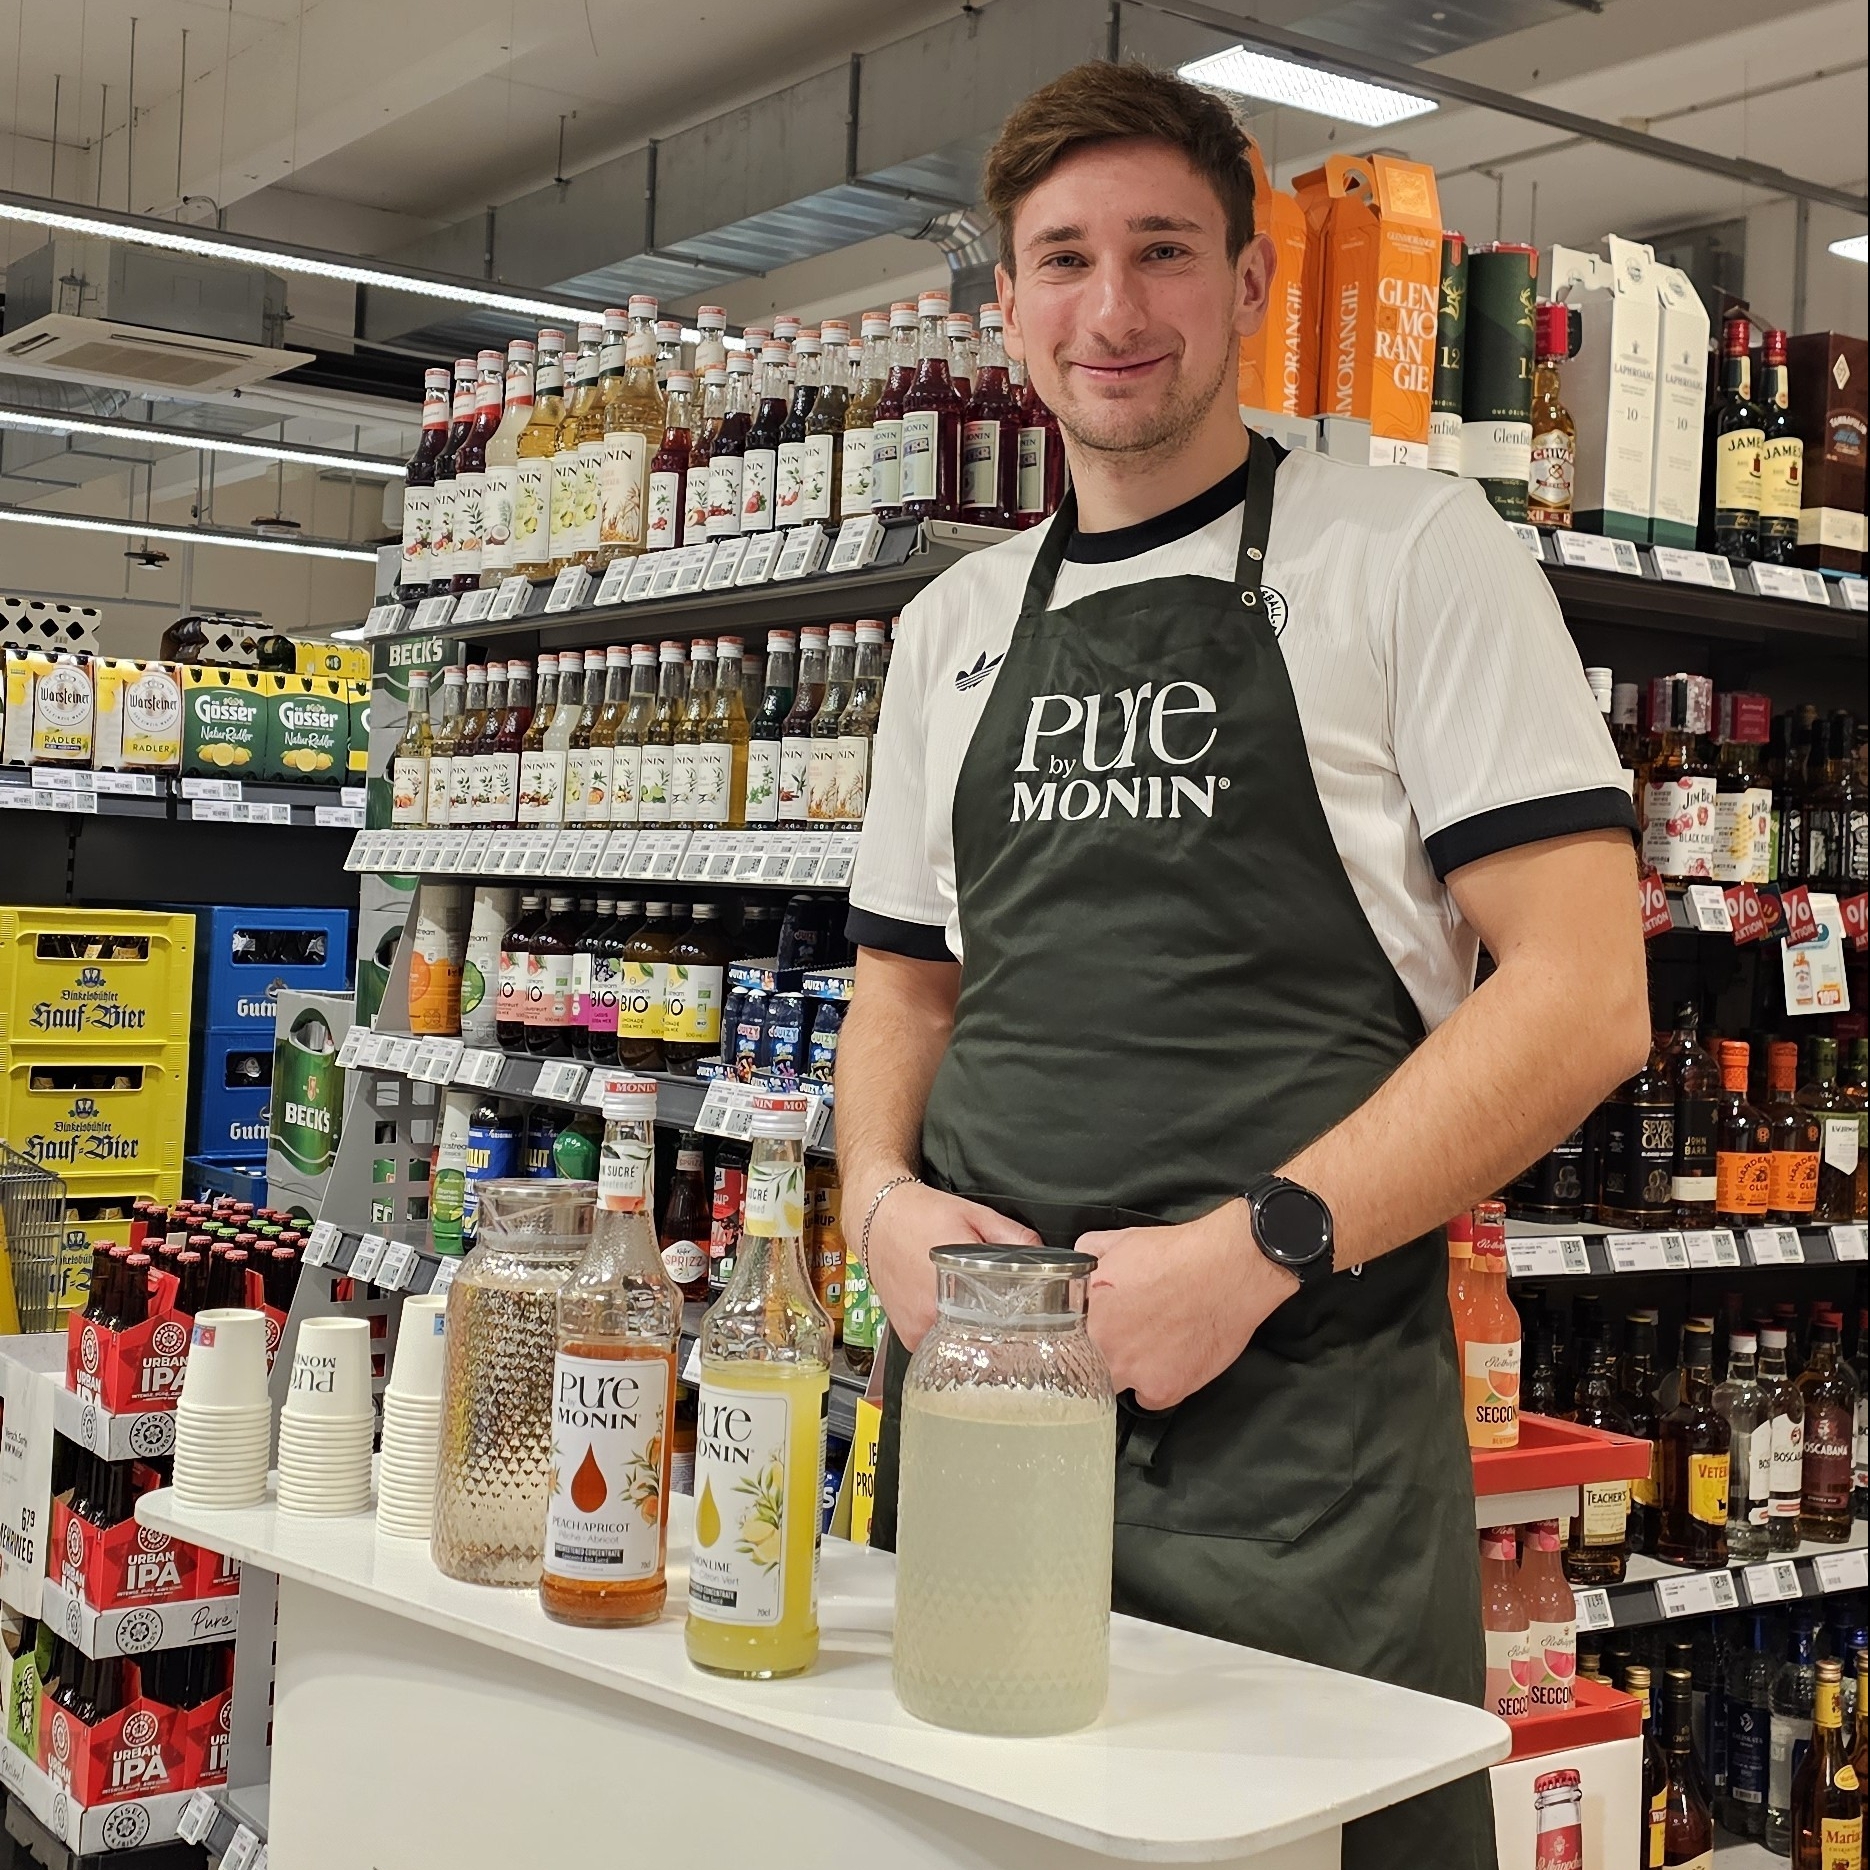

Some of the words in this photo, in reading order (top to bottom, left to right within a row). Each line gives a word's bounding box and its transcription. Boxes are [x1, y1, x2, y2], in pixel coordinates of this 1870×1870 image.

[1378, 277, 1439, 312] GLEN
[1398, 307, 1438, 338] MO
[1375, 330, 1423, 364] RAN
[1441, 346, 1460, 370] 12
[1393, 363, 1430, 393] GIE
[1627, 407, 1638, 421] 10
[1677, 417, 1688, 431] 10
[1392, 445, 1408, 466] 12
[388, 637, 444, 668] BECK'S
[40, 687, 90, 707] Warsteiner
[129, 694, 178, 712] Warsteiner
[1014, 680, 1218, 773] Pure
[44, 735, 82, 745] RADLER
[132, 743, 170, 753] RADLER
[1048, 754, 1077, 778] by
[1734, 919, 1765, 942] AKTION
[620, 995, 648, 1013] BIO
[285, 1101, 330, 1134] BECK'S
[608, 1165, 636, 1177] SUCRÉ
[559, 1371, 640, 1410] Pure
[133, 1414, 172, 1437] MAISEL
[557, 1408, 638, 1430] MONIN
[552, 1516, 580, 1532] PEACH
[581, 1521, 631, 1533] APRICOT
[128, 1551, 175, 1566] URBAN
[709, 1560, 732, 1574] LIME
[127, 1562, 181, 1590] IPA
[721, 1574, 739, 1586] Vert
[120, 1611, 157, 1637] MAISEL
[190, 1606, 233, 1637] Pure
[113, 1744, 161, 1761] URBAN
[112, 1754, 168, 1787] IPA
[106, 1804, 144, 1832] MAISEL
